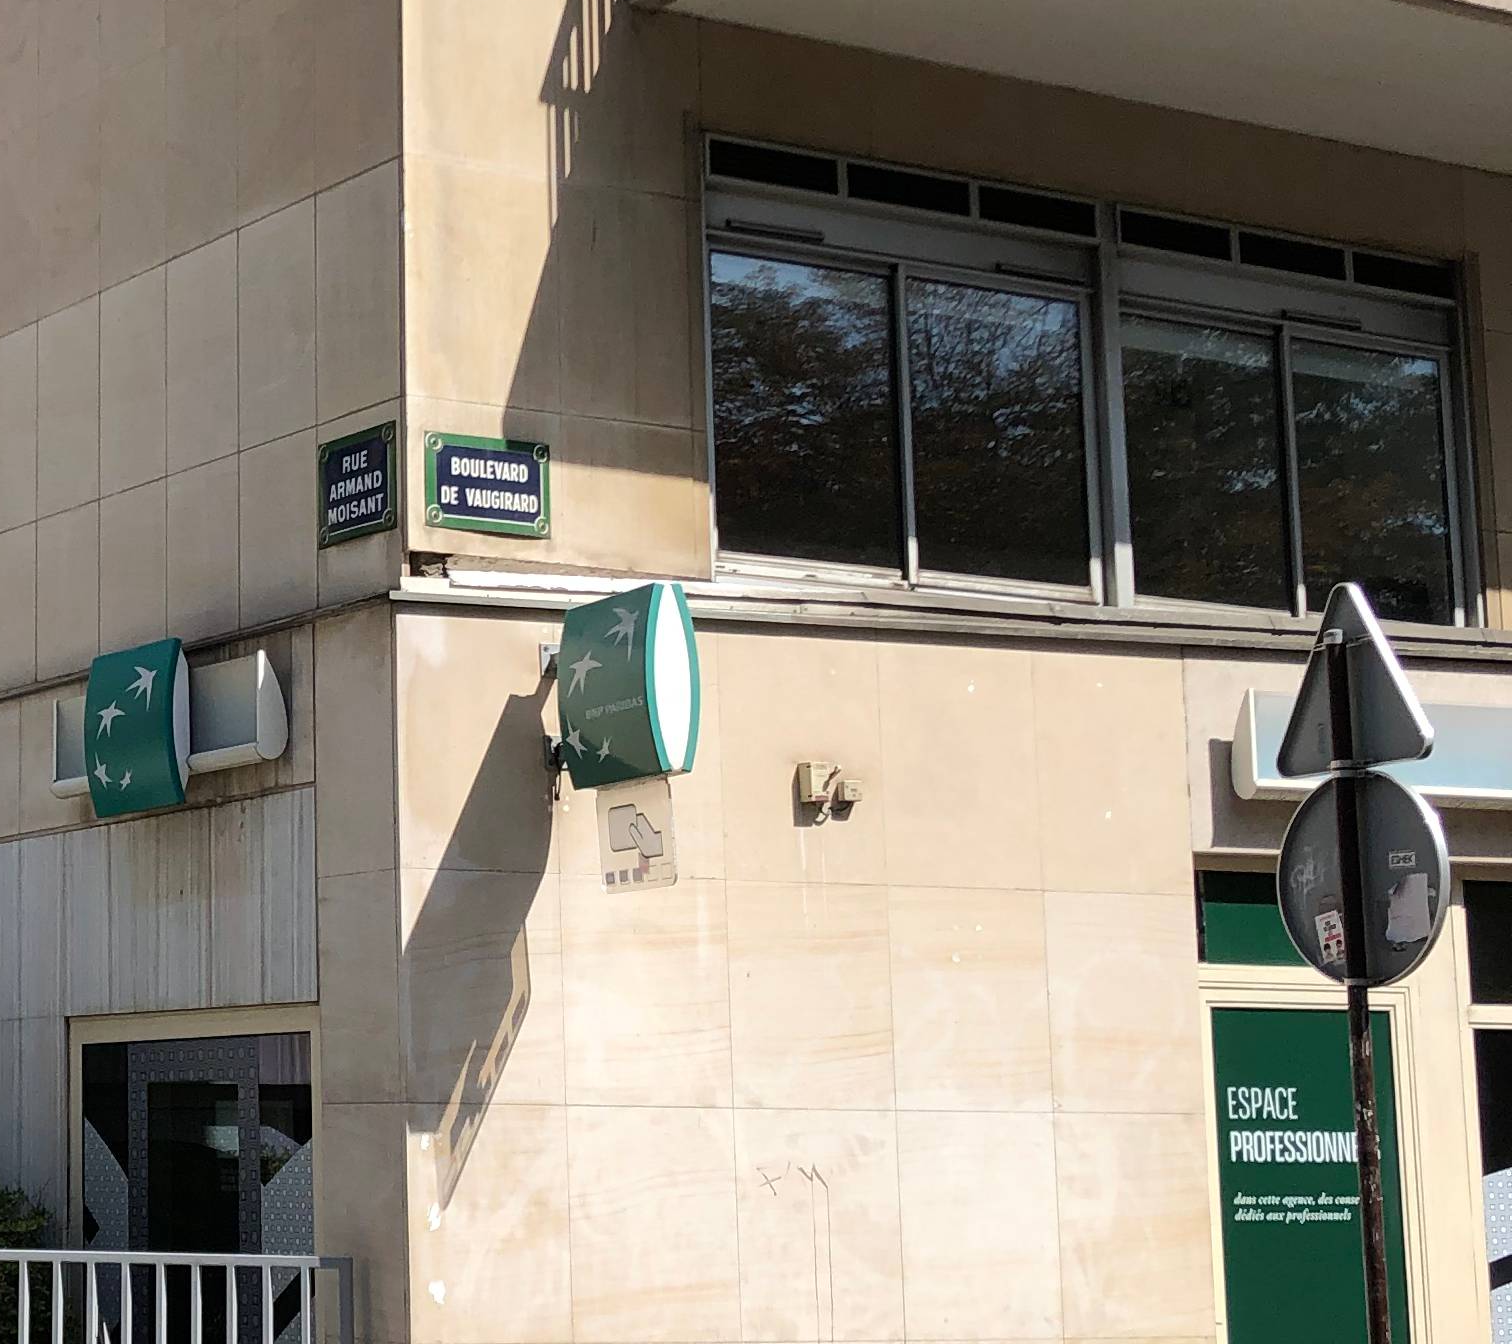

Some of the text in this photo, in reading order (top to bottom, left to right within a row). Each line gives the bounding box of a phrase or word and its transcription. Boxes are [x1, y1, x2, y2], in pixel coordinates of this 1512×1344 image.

[342, 449, 368, 474] RUE
[450, 456, 529, 483] BOULEVARD
[329, 470, 383, 502] ARMAND
[440, 485, 538, 514] DE VAUGIRARD
[327, 493, 385, 526] MOISANT
[1226, 1086, 1299, 1121] ESPACE
[1229, 1130, 1381, 1163] PROFESSIONNE
[1233, 1192, 1257, 1205] dans
[1257, 1195, 1281, 1205] cette
[1282, 1195, 1316, 1208] agence,
[1317, 1192, 1334, 1205] des
[1234, 1208, 1352, 1225] dédiés aux professionnels
